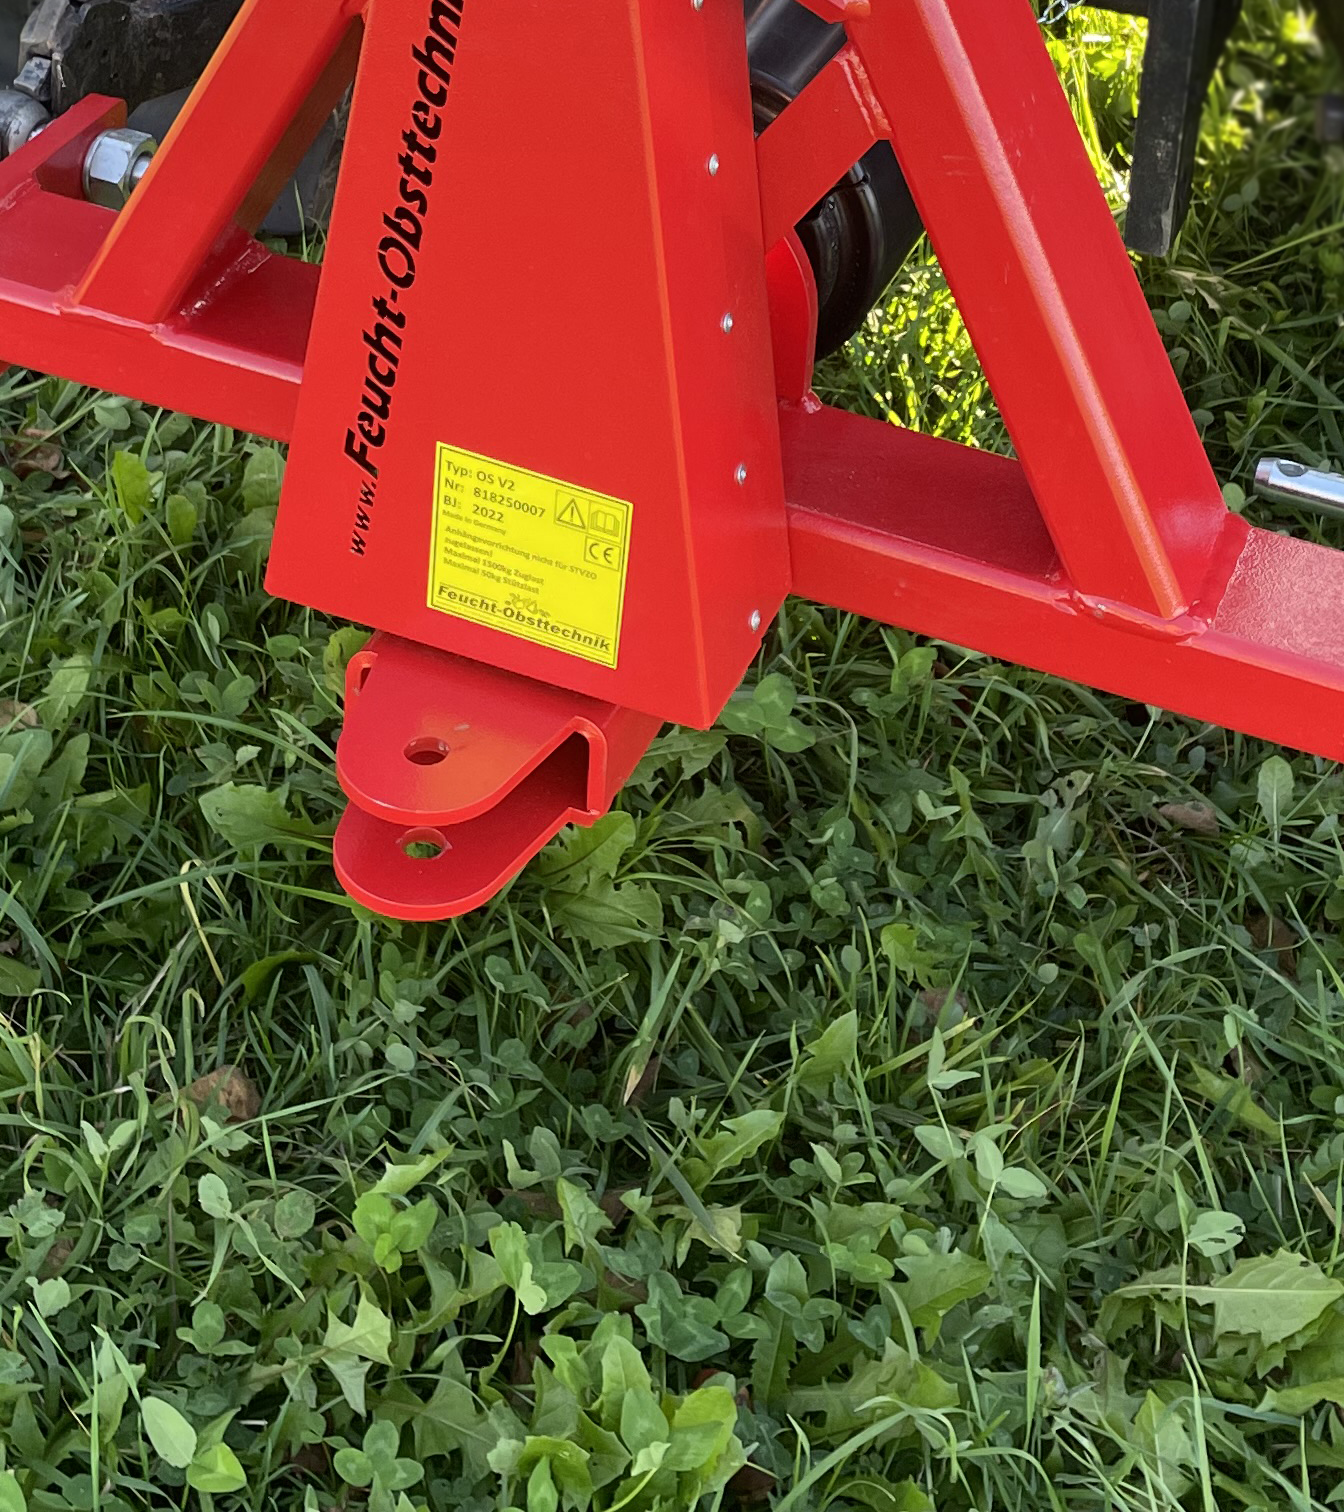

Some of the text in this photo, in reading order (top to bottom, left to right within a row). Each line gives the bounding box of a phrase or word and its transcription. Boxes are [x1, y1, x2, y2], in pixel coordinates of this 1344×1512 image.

[445, 460, 515, 491] Typ: OS V2
[444, 477, 546, 518] Nr: 818250007
[442, 509, 463, 521] Made
[473, 520, 506, 535] Germany
[472, 503, 504, 523] 2022
[443, 557, 480, 574] Maximal
[444, 547, 480, 564] Maximal
[532, 554, 553, 566] nicht
[555, 559, 568, 570] für
[437, 585, 611, 652] Feucht-Obsttechnik
